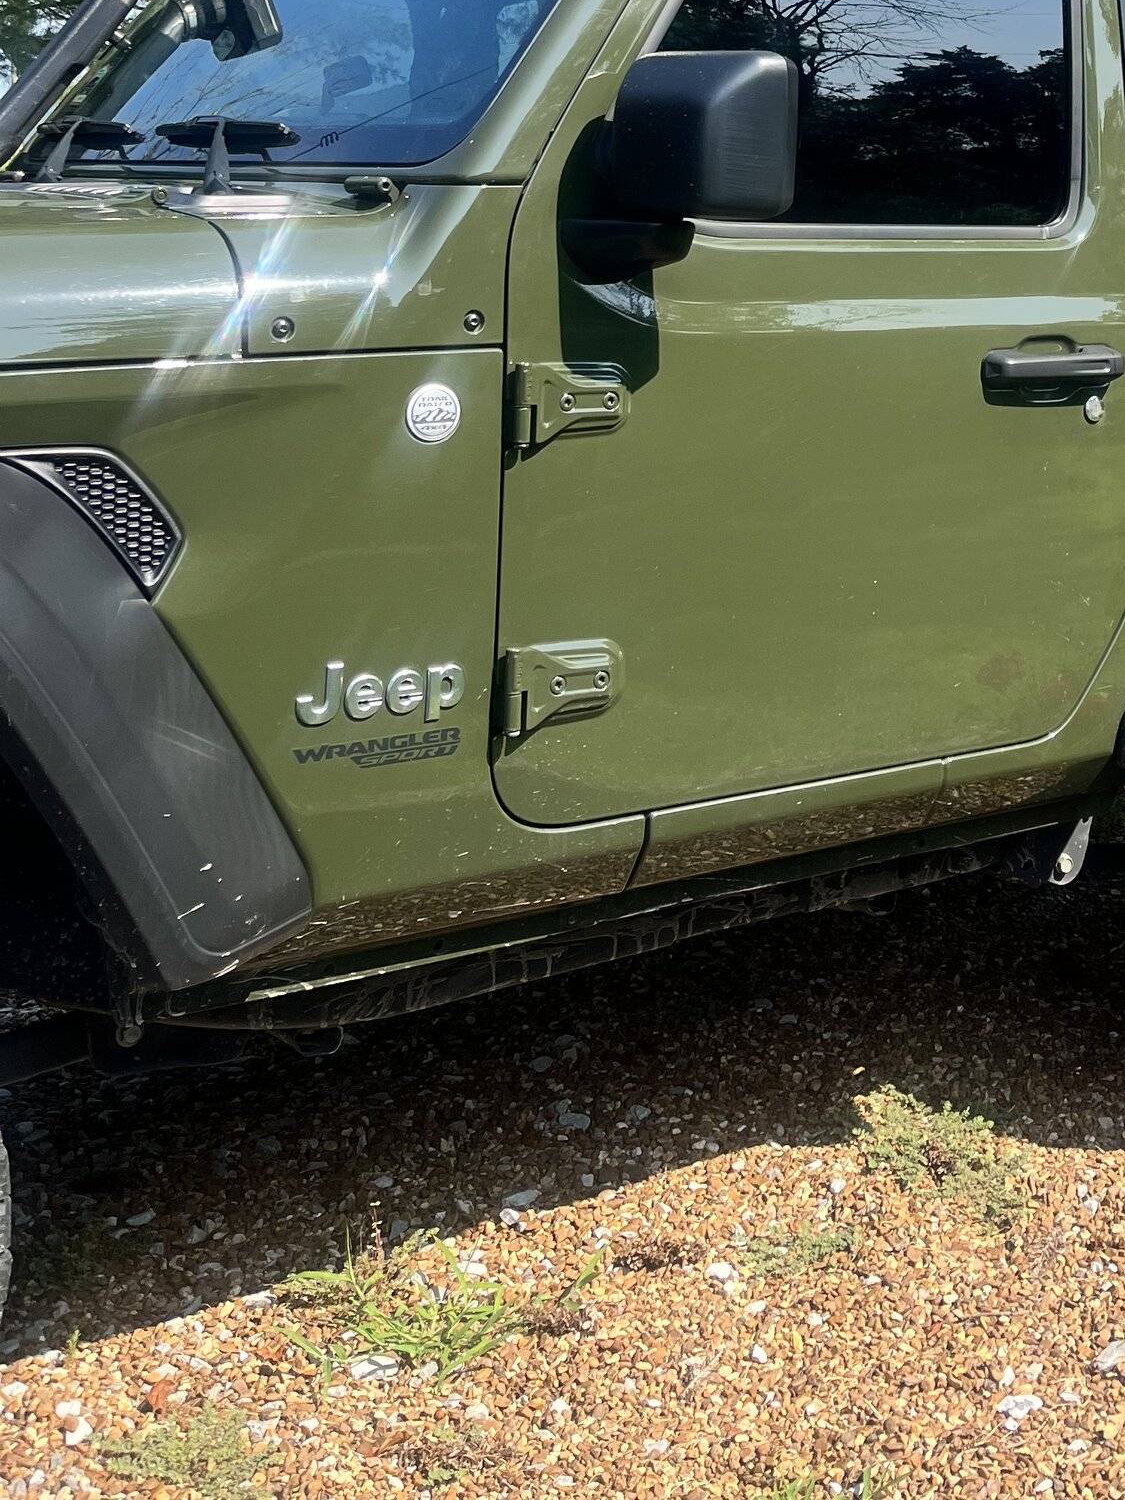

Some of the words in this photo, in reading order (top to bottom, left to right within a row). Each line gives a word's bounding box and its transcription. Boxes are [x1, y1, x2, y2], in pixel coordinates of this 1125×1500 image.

[295, 660, 465, 727] Jeep
[293, 727, 461, 764] WRANGLER
[353, 744, 459, 768] SPORT
